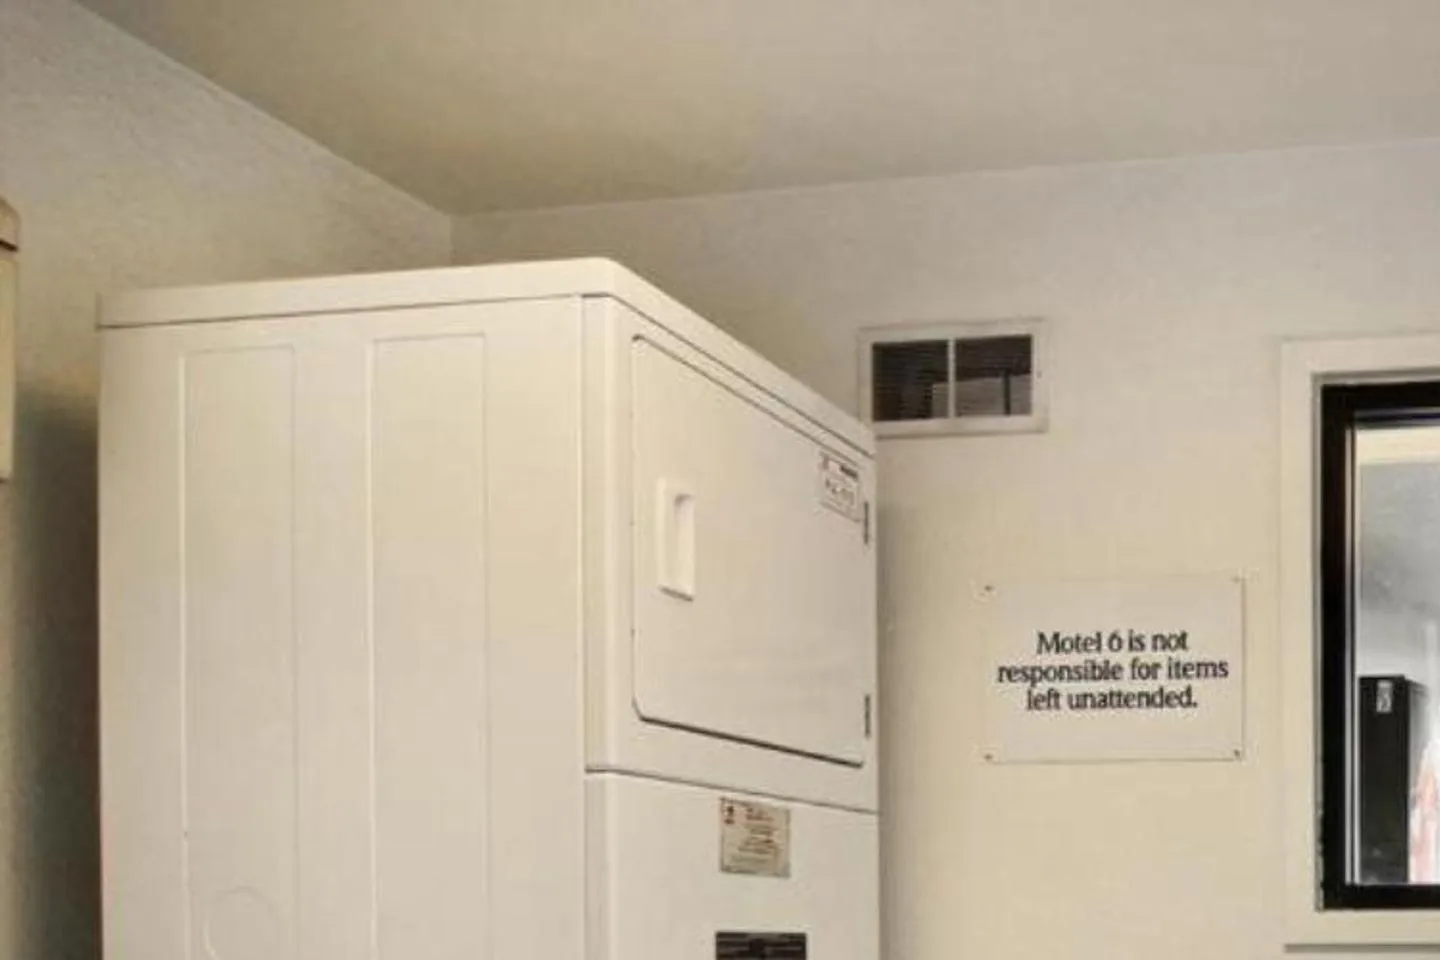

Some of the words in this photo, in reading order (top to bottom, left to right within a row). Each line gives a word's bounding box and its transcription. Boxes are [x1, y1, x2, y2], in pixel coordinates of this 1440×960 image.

[1036, 630, 1101, 654] Motel
[1107, 630, 1122, 652] 6
[1128, 629, 1145, 651] is
[1151, 630, 1188, 651] not
[997, 659, 1123, 687] responsible
[1130, 657, 1162, 681] for
[1167, 657, 1229, 679] items
[1027, 688, 1061, 711] left
[1067, 685, 1198, 709] unattended.
